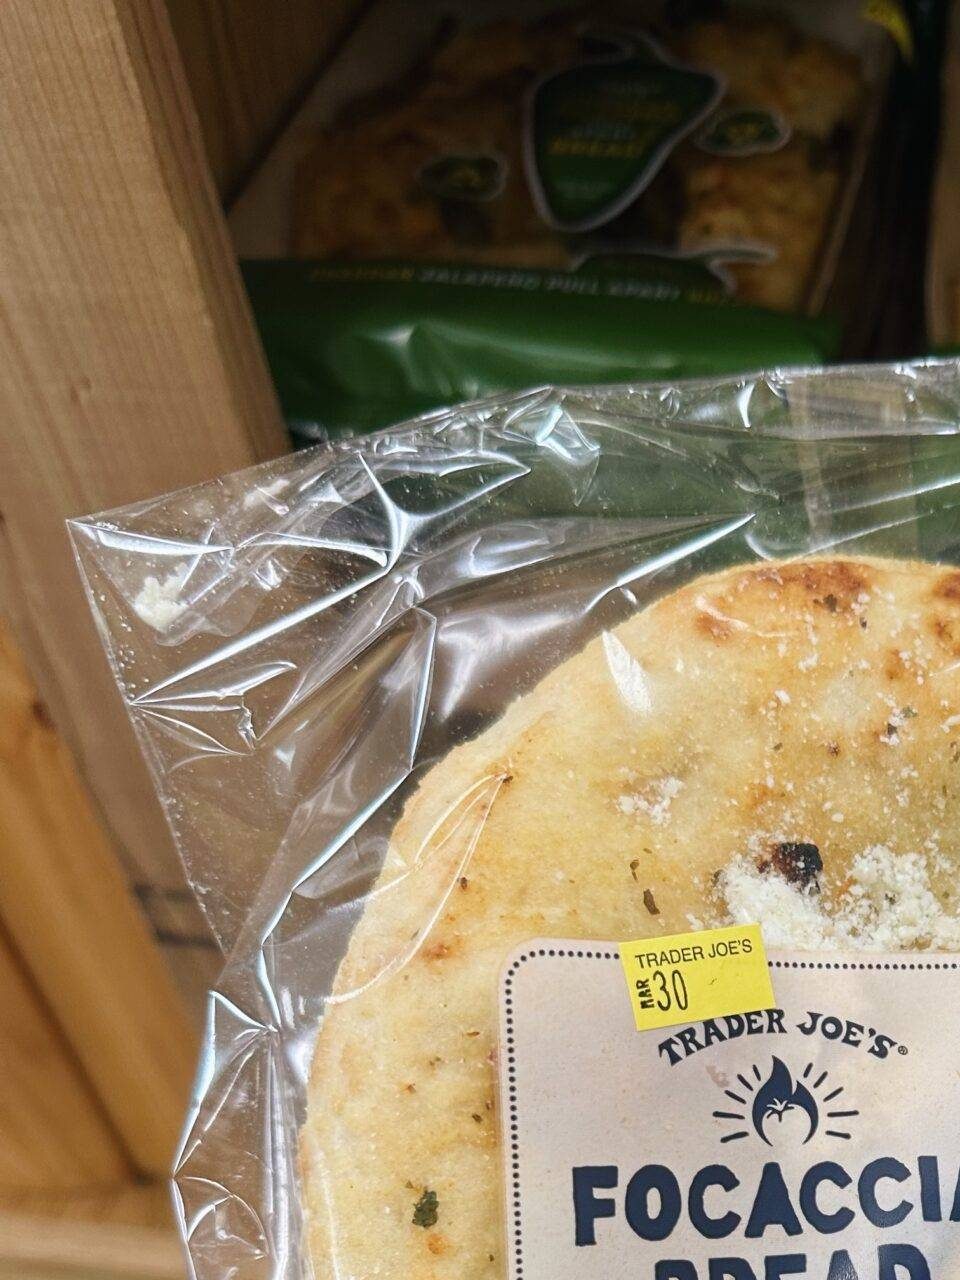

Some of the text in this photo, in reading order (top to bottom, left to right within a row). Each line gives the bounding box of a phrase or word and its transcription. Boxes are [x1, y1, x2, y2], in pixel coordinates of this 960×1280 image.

[635, 938, 753, 969] TRADER JOE'S
[636, 969, 688, 1012] MAR 30
[657, 1008, 787, 1067] TRADER
